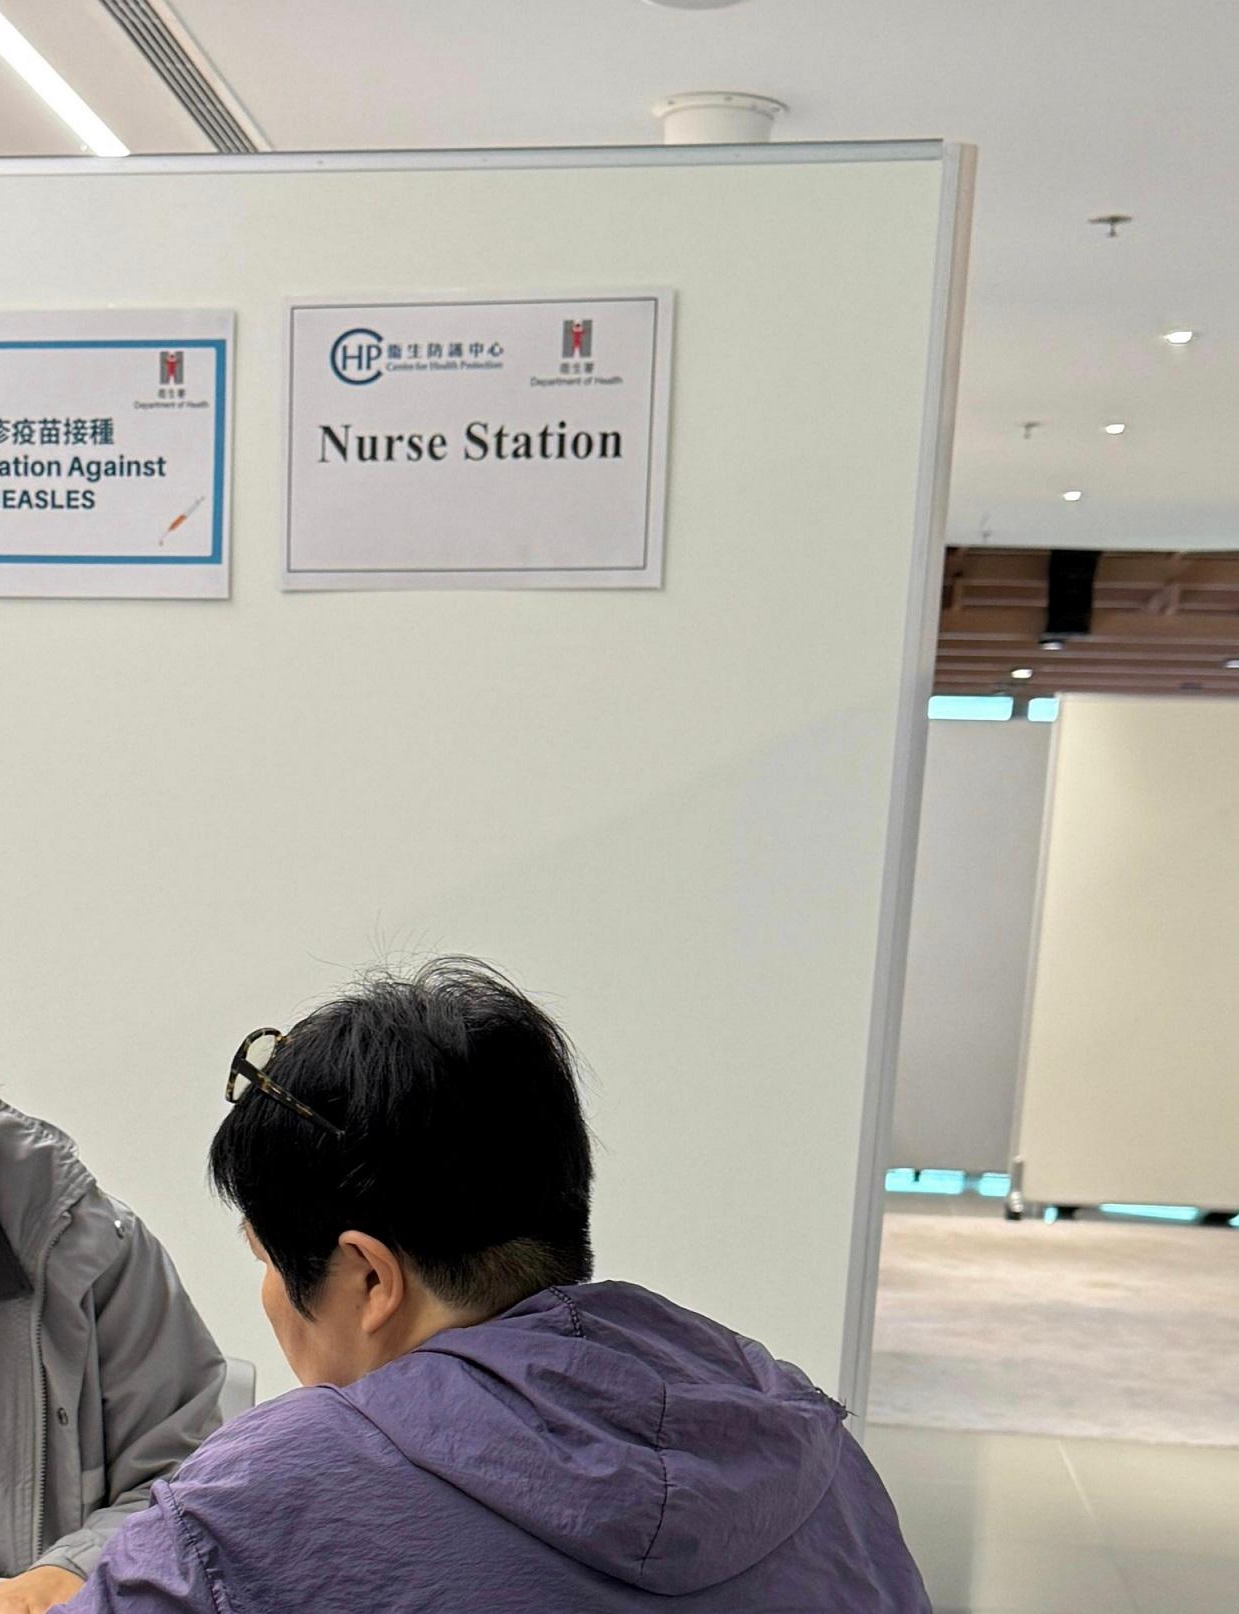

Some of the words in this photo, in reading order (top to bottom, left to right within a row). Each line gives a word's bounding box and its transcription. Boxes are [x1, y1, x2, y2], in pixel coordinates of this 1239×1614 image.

[530, 376, 582, 387] Department
[583, 376, 593, 386] of
[594, 376, 624, 385] Health
[317, 424, 448, 464] Nurse
[463, 420, 624, 461] Station
[67, 454, 167, 483] Against
